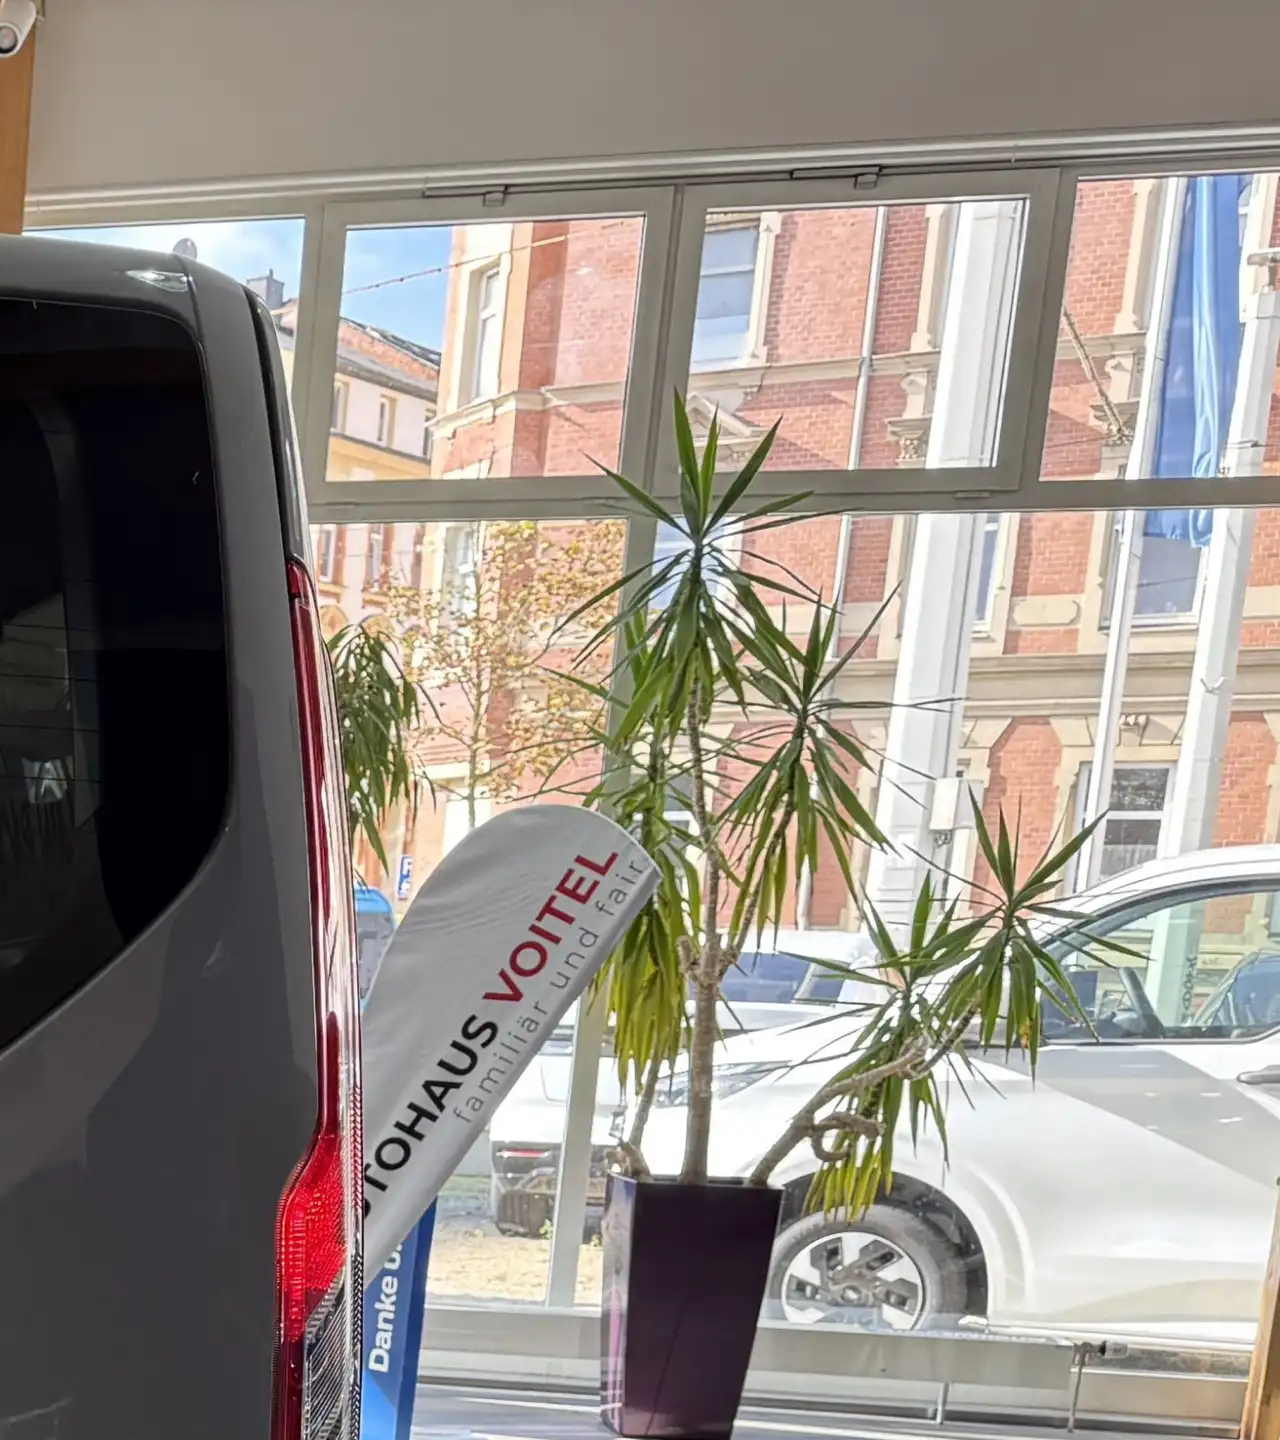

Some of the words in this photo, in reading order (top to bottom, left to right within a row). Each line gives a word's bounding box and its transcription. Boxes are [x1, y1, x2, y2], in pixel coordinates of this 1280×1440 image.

[363, 1014, 498, 1219] TOHAUS
[483, 852, 620, 1003] VOITEL
[452, 1000, 549, 1125] familiär
[550, 927, 600, 989] und
[596, 859, 645, 918] fair
[368, 1275, 399, 1373] Danke
